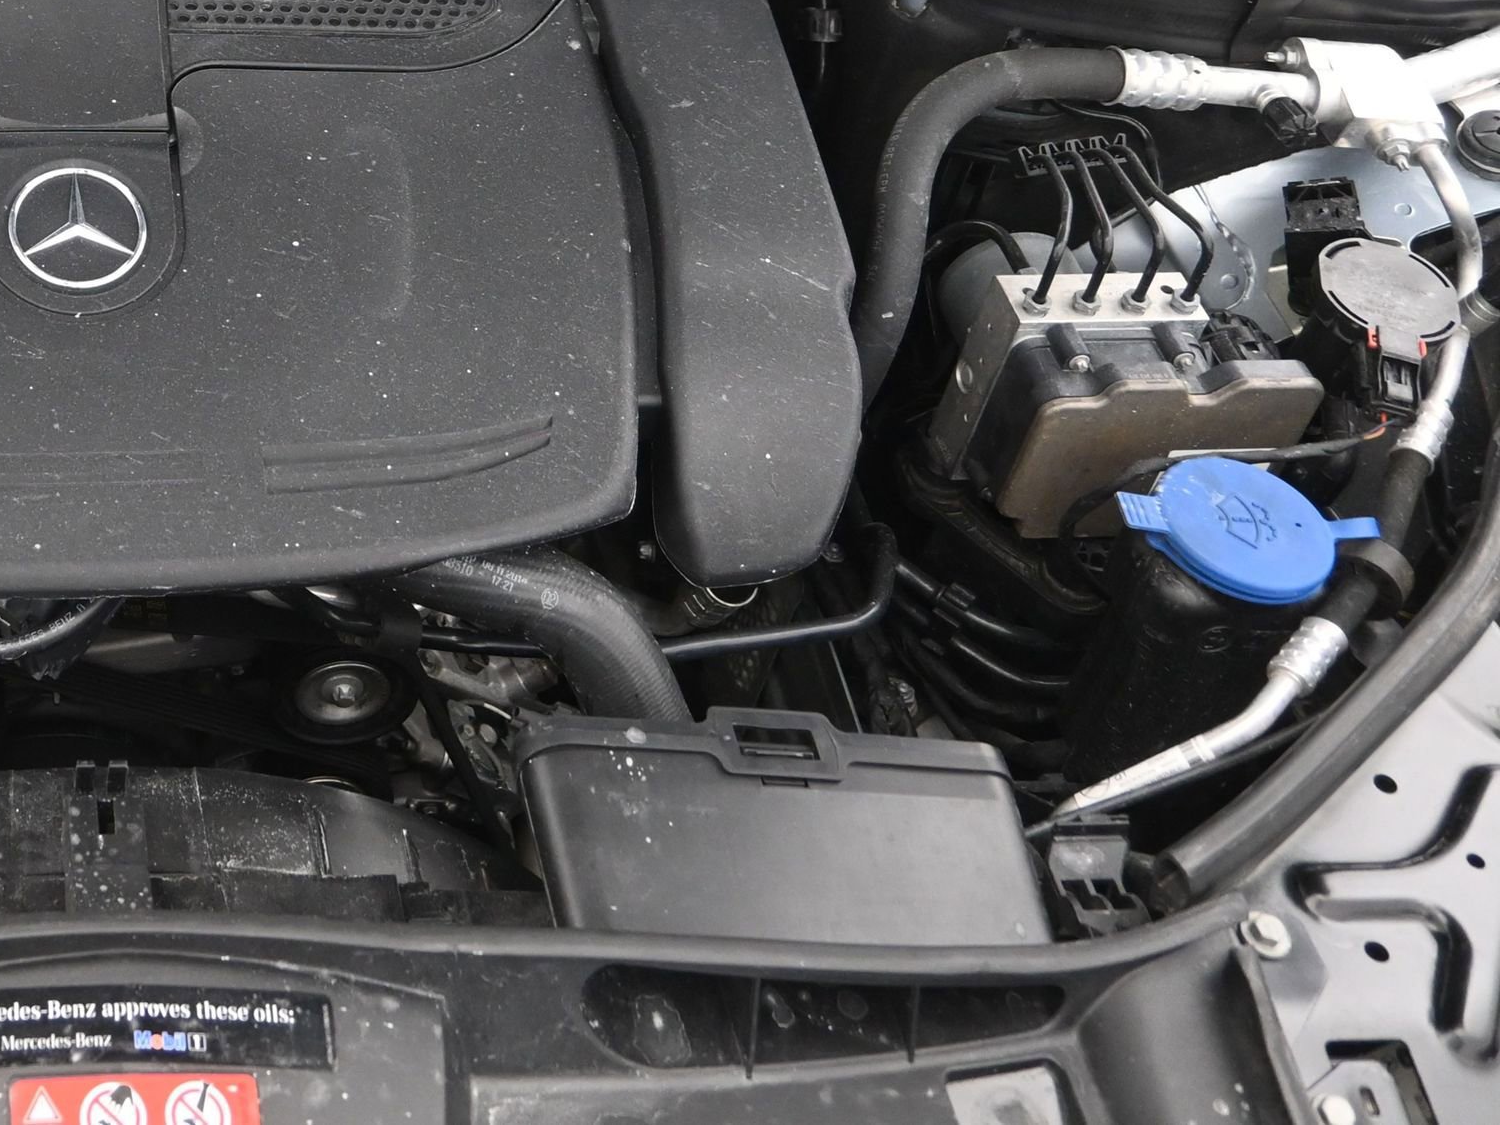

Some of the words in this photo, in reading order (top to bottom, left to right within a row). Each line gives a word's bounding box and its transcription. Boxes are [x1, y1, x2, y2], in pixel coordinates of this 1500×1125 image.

[101, 1001, 192, 1024] approves
[195, 999, 251, 1023] these
[253, 1001, 296, 1024] oils:
[0, 1031, 112, 1052] Mercedes-Benz
[133, 1028, 187, 1052] Mobil
